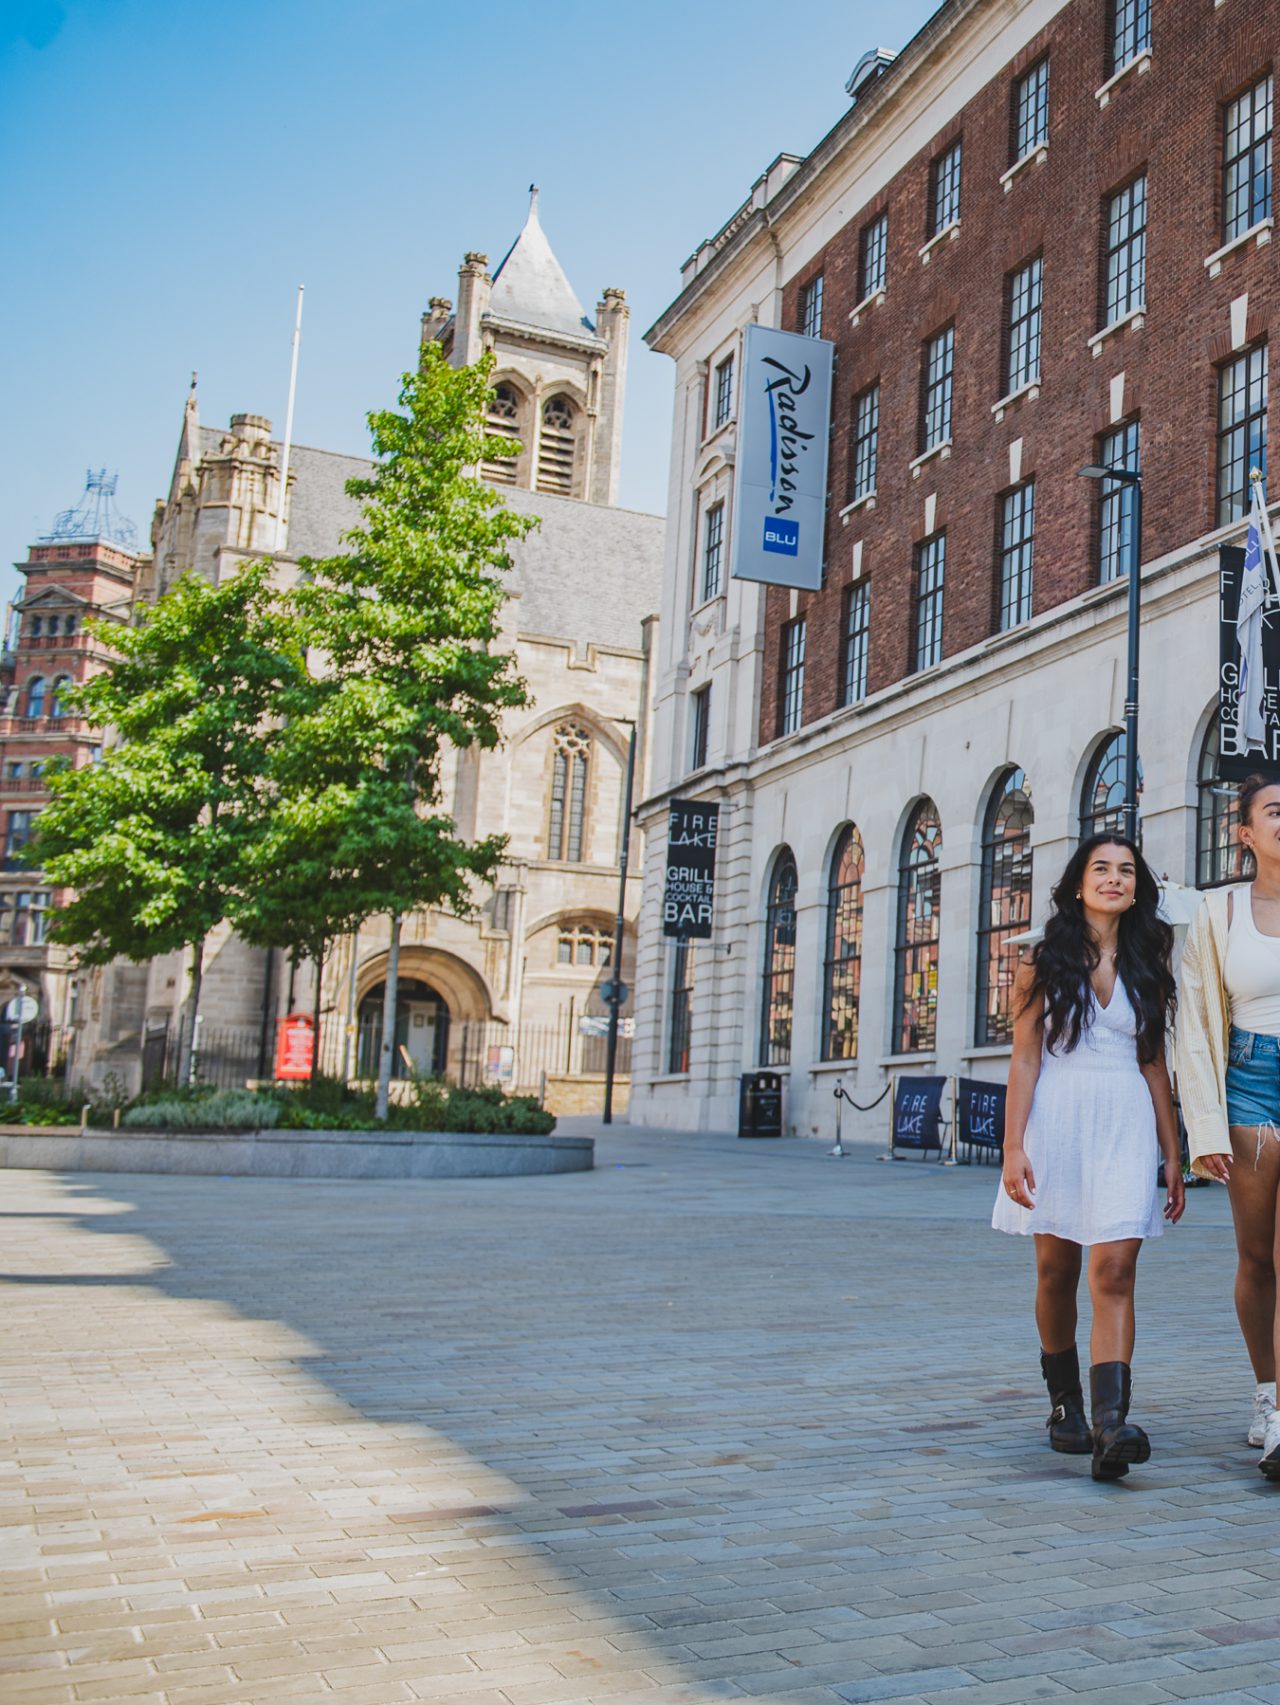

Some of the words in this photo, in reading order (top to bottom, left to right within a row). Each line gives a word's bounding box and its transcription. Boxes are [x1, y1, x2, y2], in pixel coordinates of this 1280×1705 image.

[761, 356, 815, 514] Radisson
[765, 530, 796, 547] BLU
[669, 812, 718, 831] FIRE
[668, 830, 716, 849] LAKE
[667, 866, 714, 883] GRILL
[666, 880, 704, 894] HOUSE
[665, 892, 712, 905] COCKTAIL
[664, 901, 713, 924] BAR
[901, 1094, 928, 1113] FIRE
[970, 1092, 997, 1115] FIRE
[897, 1115, 924, 1134] LAKE
[969, 1114, 995, 1137] LAKE
